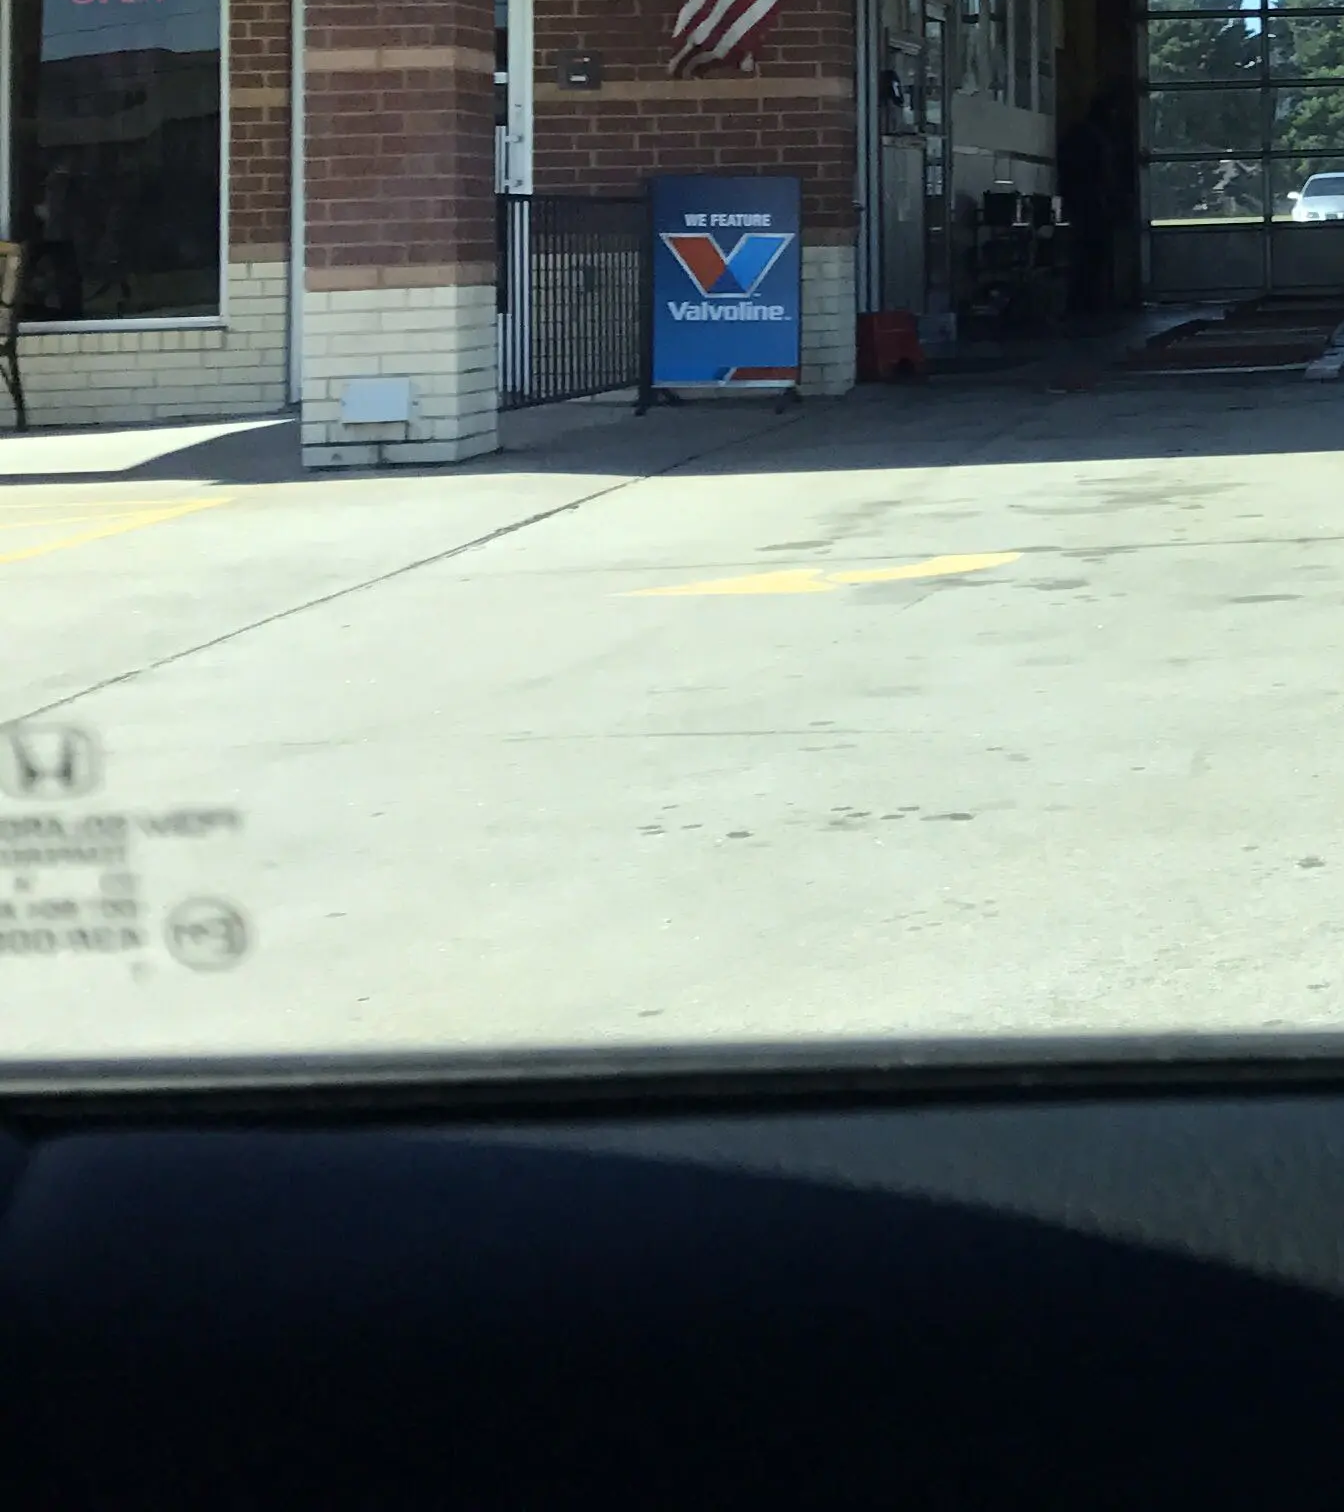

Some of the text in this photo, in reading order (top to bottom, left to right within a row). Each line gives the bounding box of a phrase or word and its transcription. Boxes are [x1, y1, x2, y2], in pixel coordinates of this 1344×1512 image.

[684, 214, 772, 227] WE FEATURE
[667, 301, 785, 321] Valvoline
